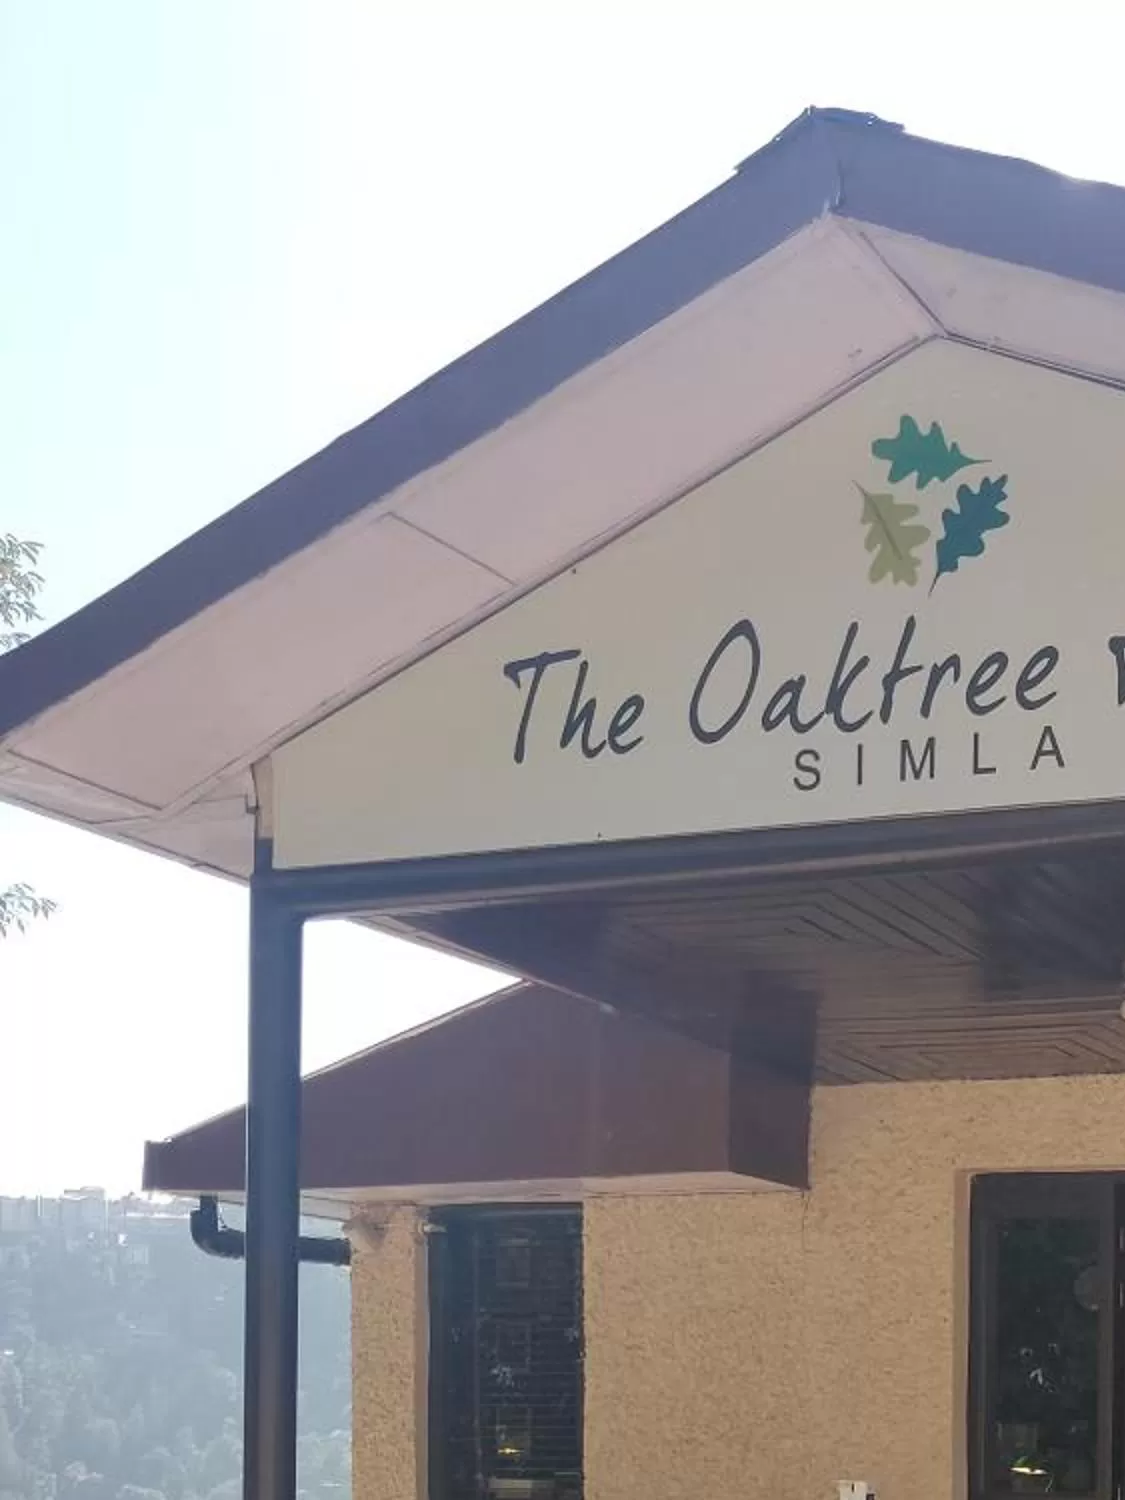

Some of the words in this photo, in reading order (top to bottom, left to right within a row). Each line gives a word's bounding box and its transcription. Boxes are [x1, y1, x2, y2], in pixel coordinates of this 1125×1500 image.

[504, 648, 645, 765] The
[688, 616, 1060, 745] Oaktree
[793, 726, 1065, 792] SIMLA
